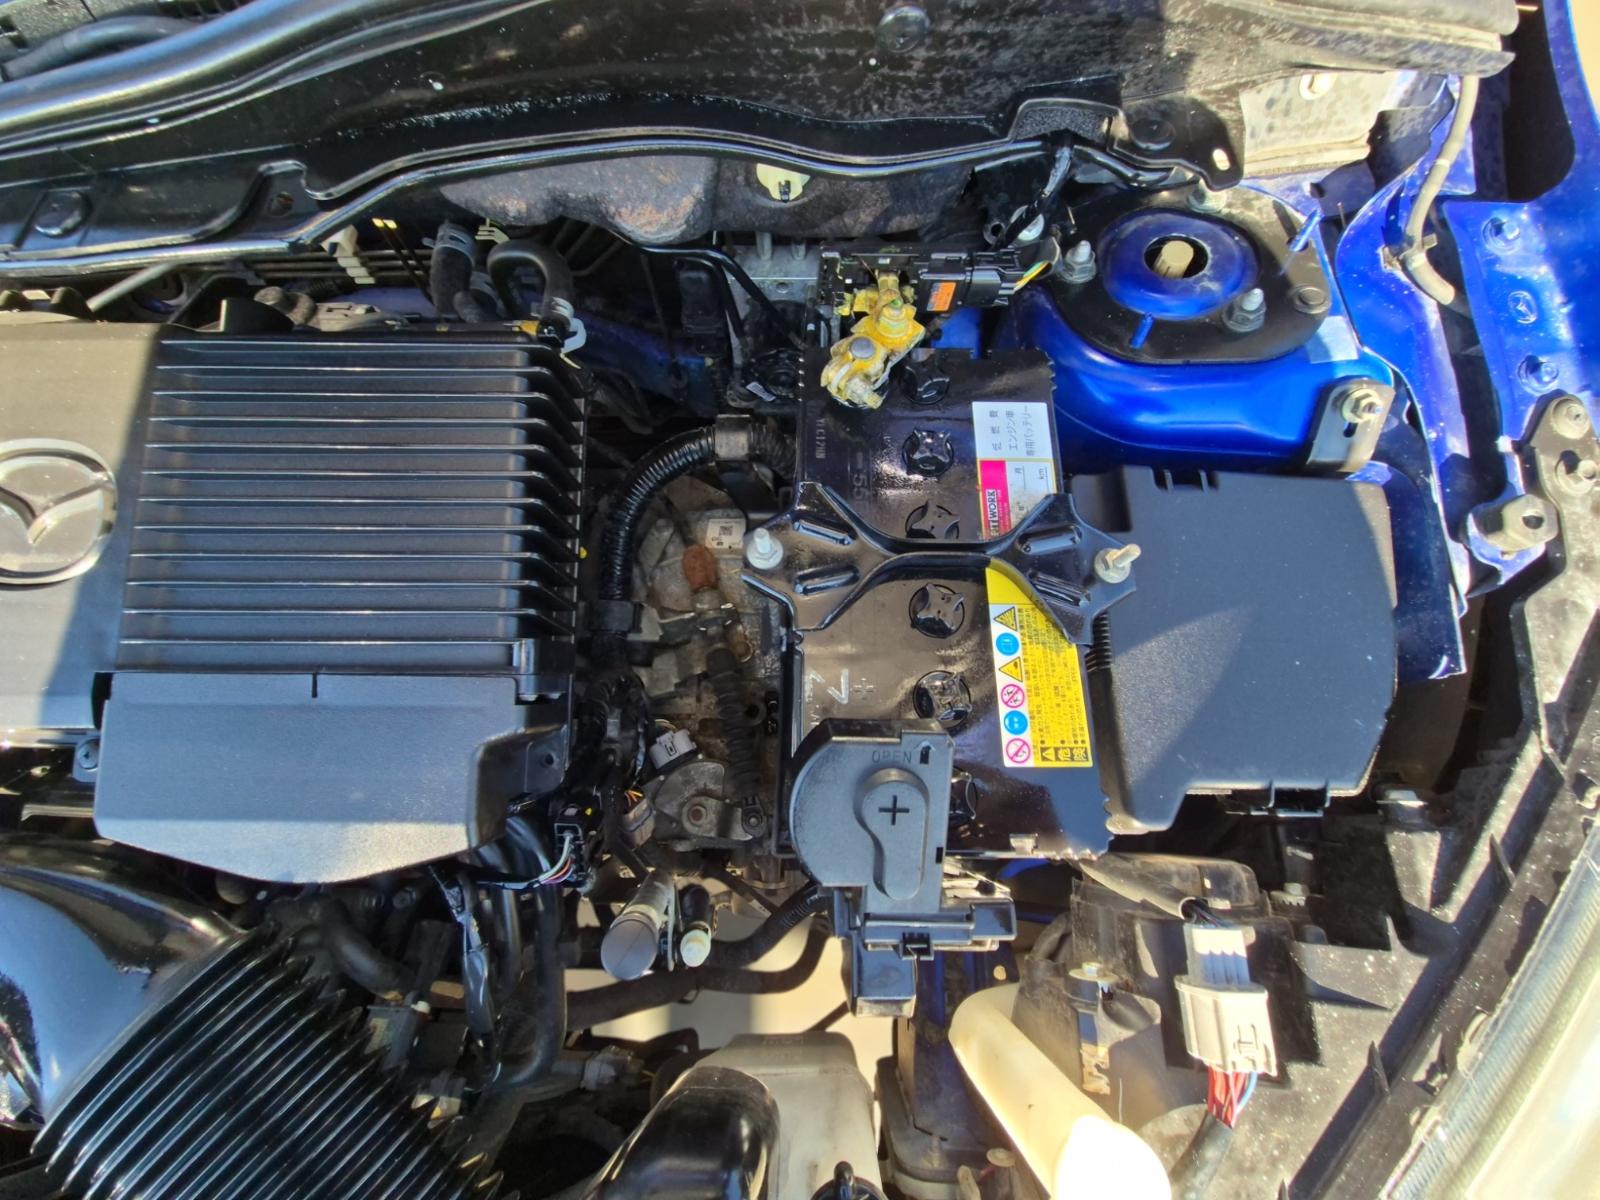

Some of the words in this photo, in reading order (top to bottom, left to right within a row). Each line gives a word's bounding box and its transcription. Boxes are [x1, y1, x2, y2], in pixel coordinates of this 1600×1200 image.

[1005, 410, 1018, 450] エンジン車
[1038, 467, 1045, 480] km
[986, 489, 999, 536] PITWORK
[871, 750, 912, 764] OPEN
